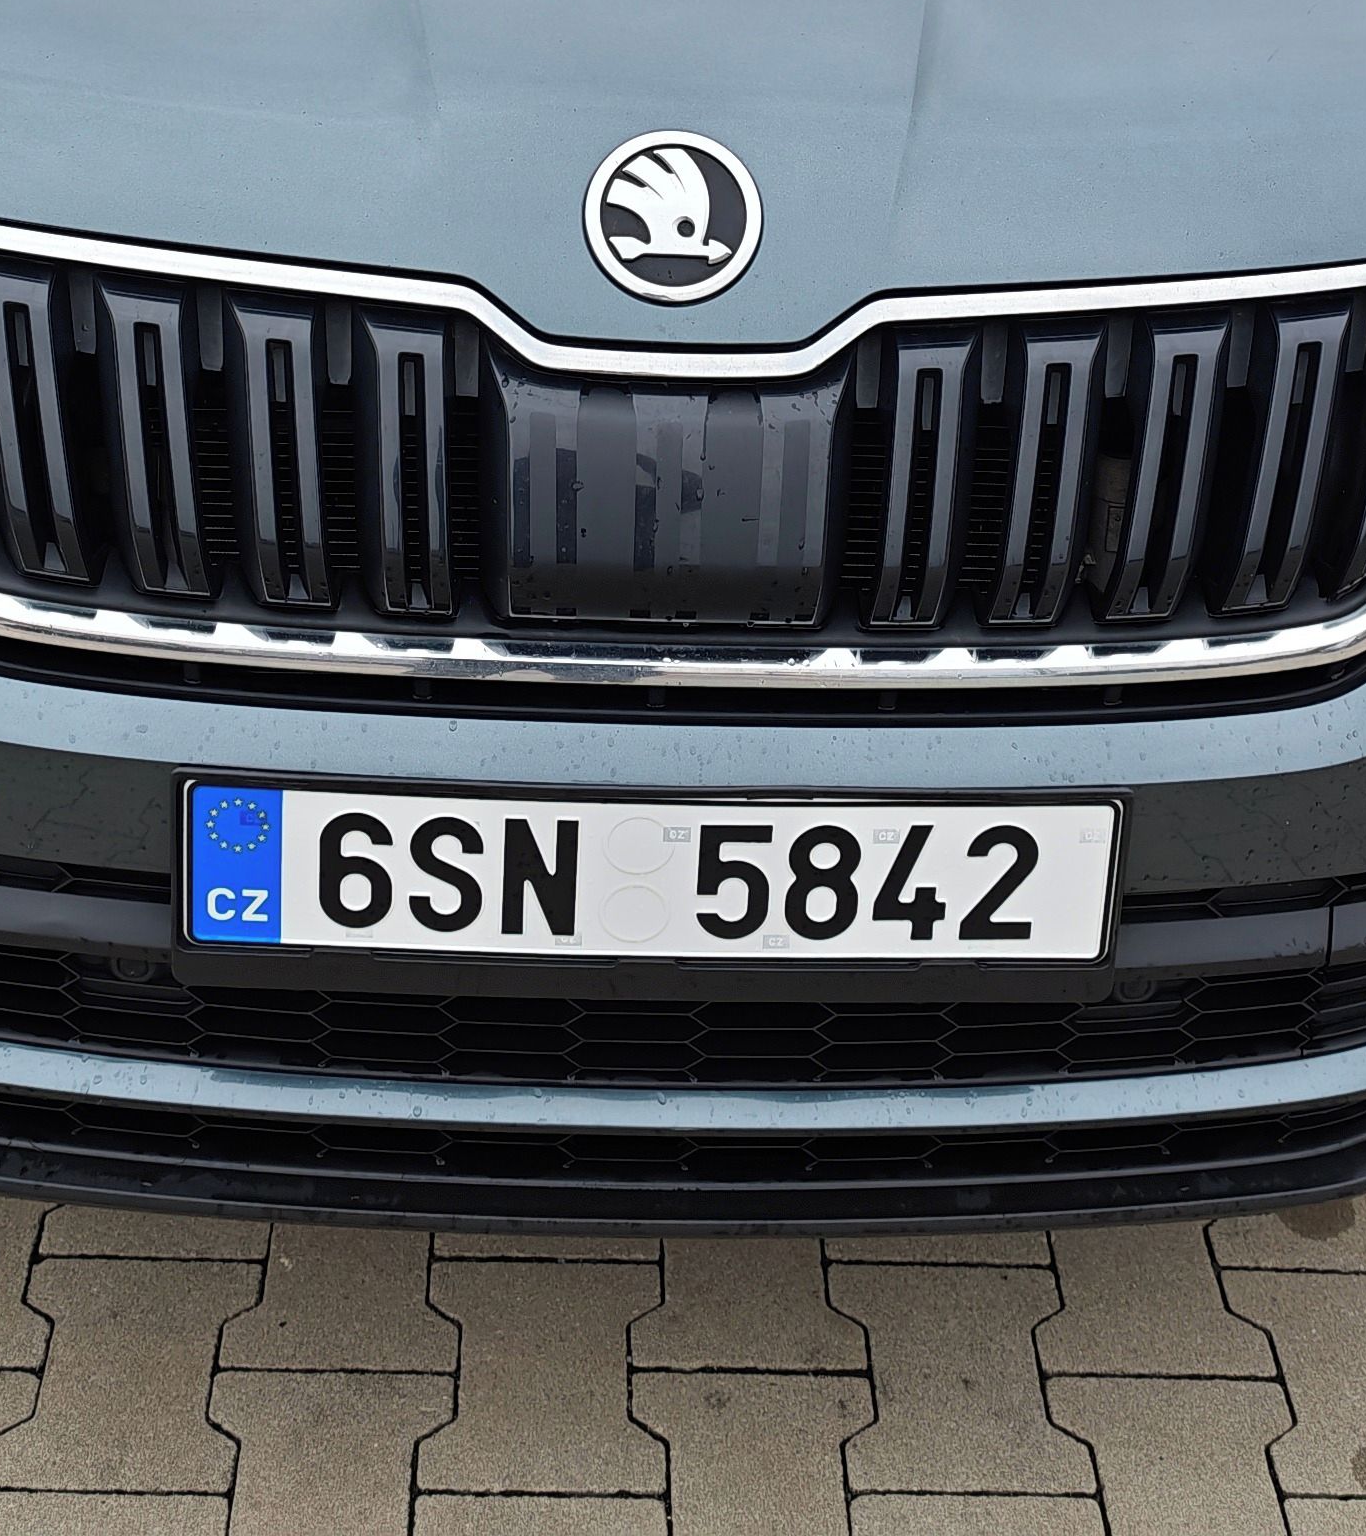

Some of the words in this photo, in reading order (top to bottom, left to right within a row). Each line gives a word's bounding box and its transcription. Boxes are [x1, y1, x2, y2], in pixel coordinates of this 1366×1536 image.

[206, 887, 269, 922] CZ
[319, 811, 579, 937] 6SN
[696, 824, 1039, 941] 5842
